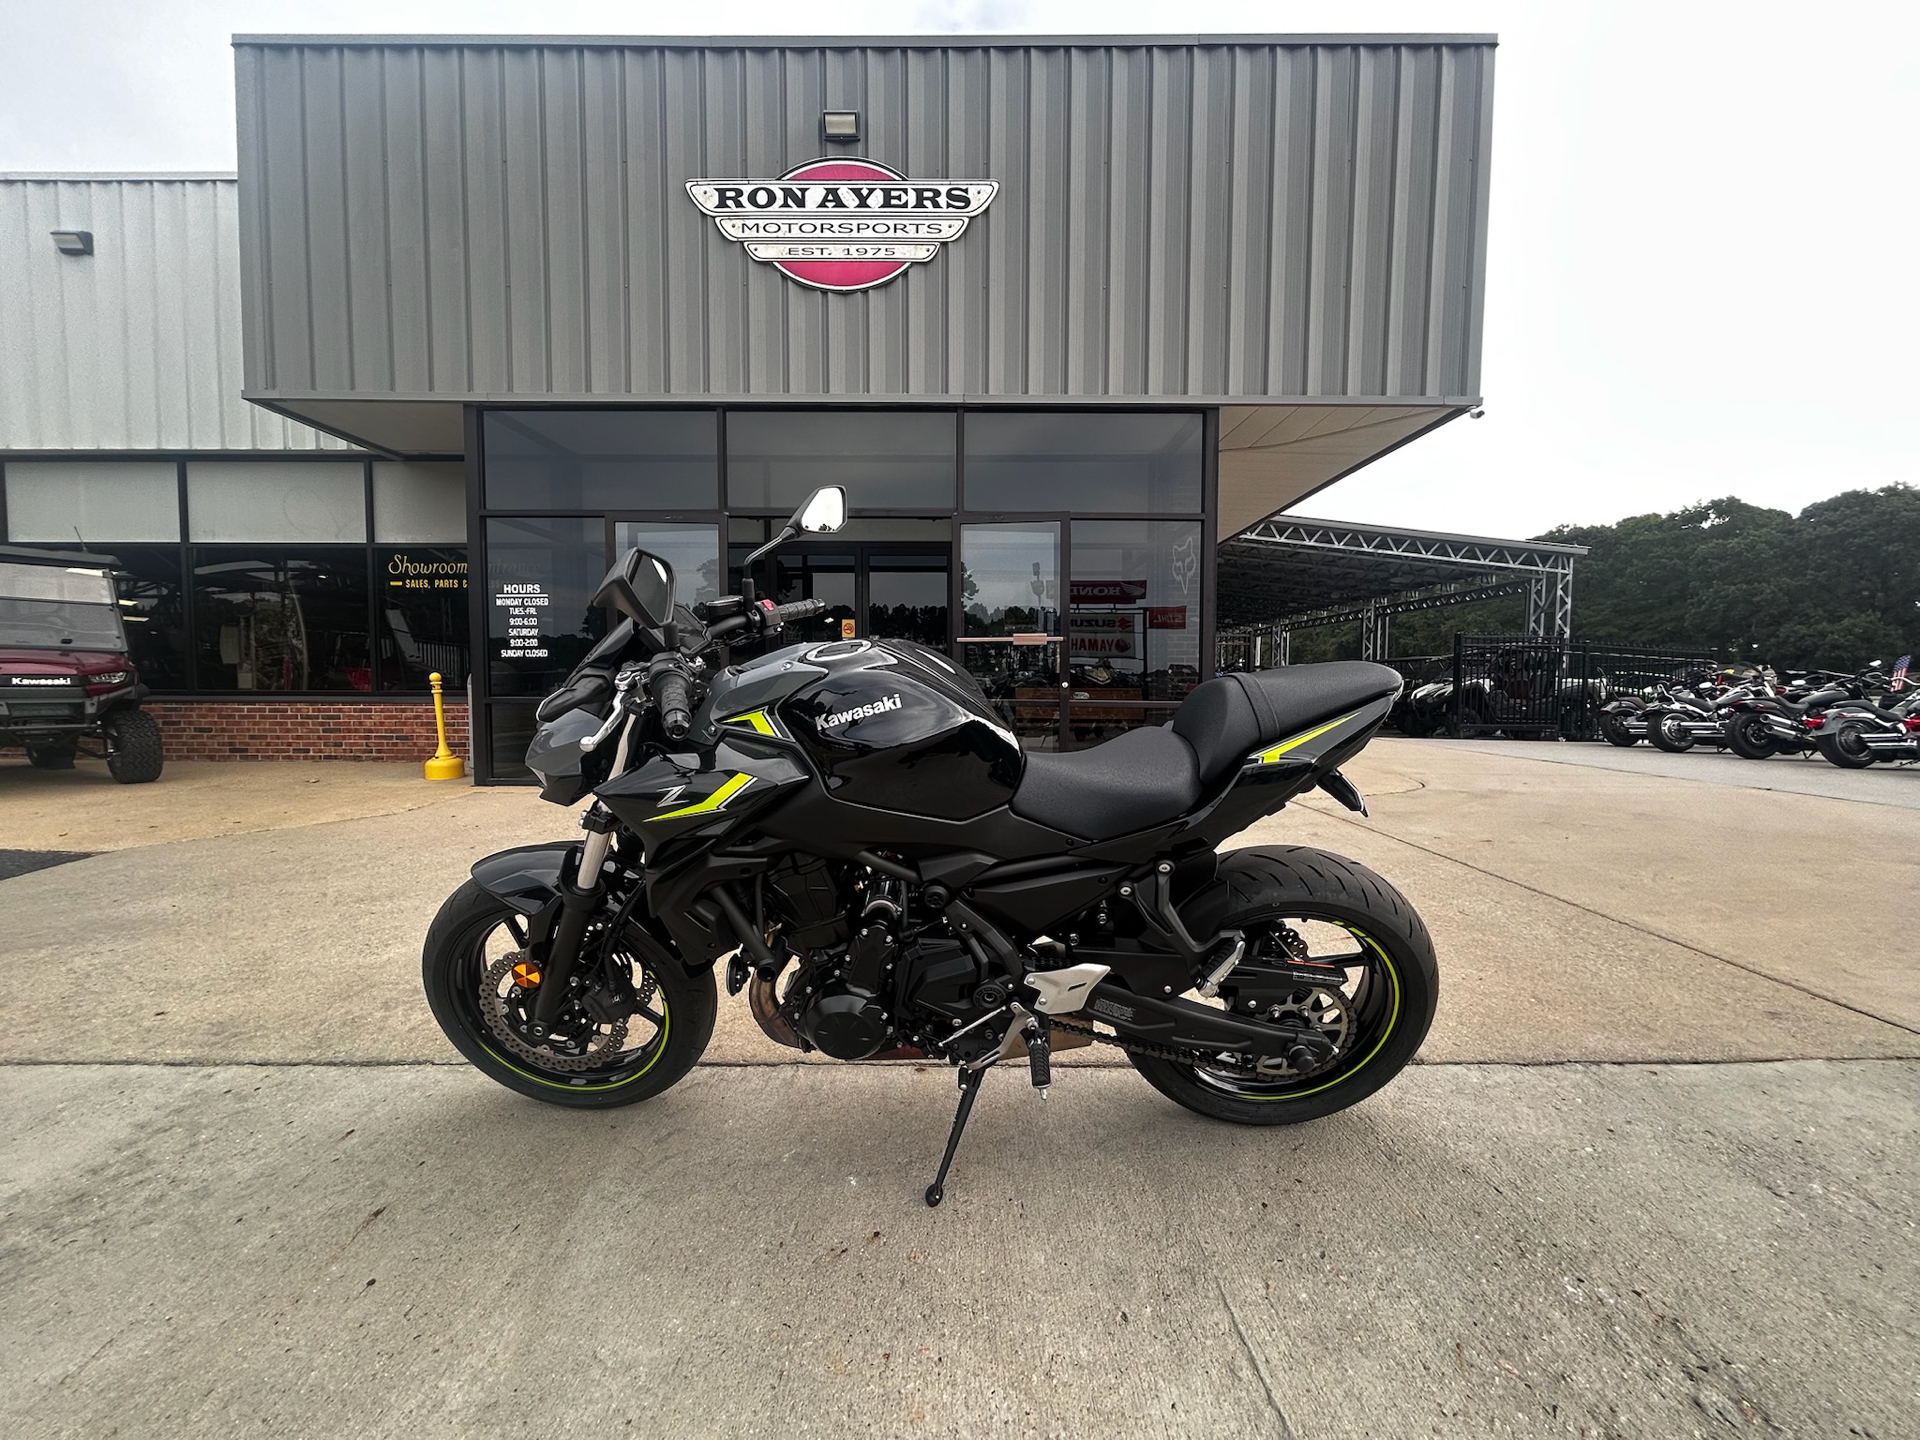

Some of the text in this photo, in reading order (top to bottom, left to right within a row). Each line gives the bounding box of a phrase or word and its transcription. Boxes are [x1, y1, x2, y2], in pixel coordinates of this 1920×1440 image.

[714, 187, 972, 209] RON AYERS
[741, 222, 942, 234] MOTORSPORTS
[788, 247, 896, 256] EST. 1975
[388, 554, 468, 575] Showroom
[405, 579, 431, 589] SALES,
[434, 579, 459, 588] PARTS
[503, 584, 541, 594] HOURS
[496, 598, 549, 606] MONDAY CLOSED
[509, 618, 538, 626] 9:00-6:00
[508, 628, 539, 636] SATURDAY
[500, 649, 549, 658] SUNDAY CLOSED
[11, 677, 71, 685] Kawasaki
[815, 693, 903, 731] Kawasaki
